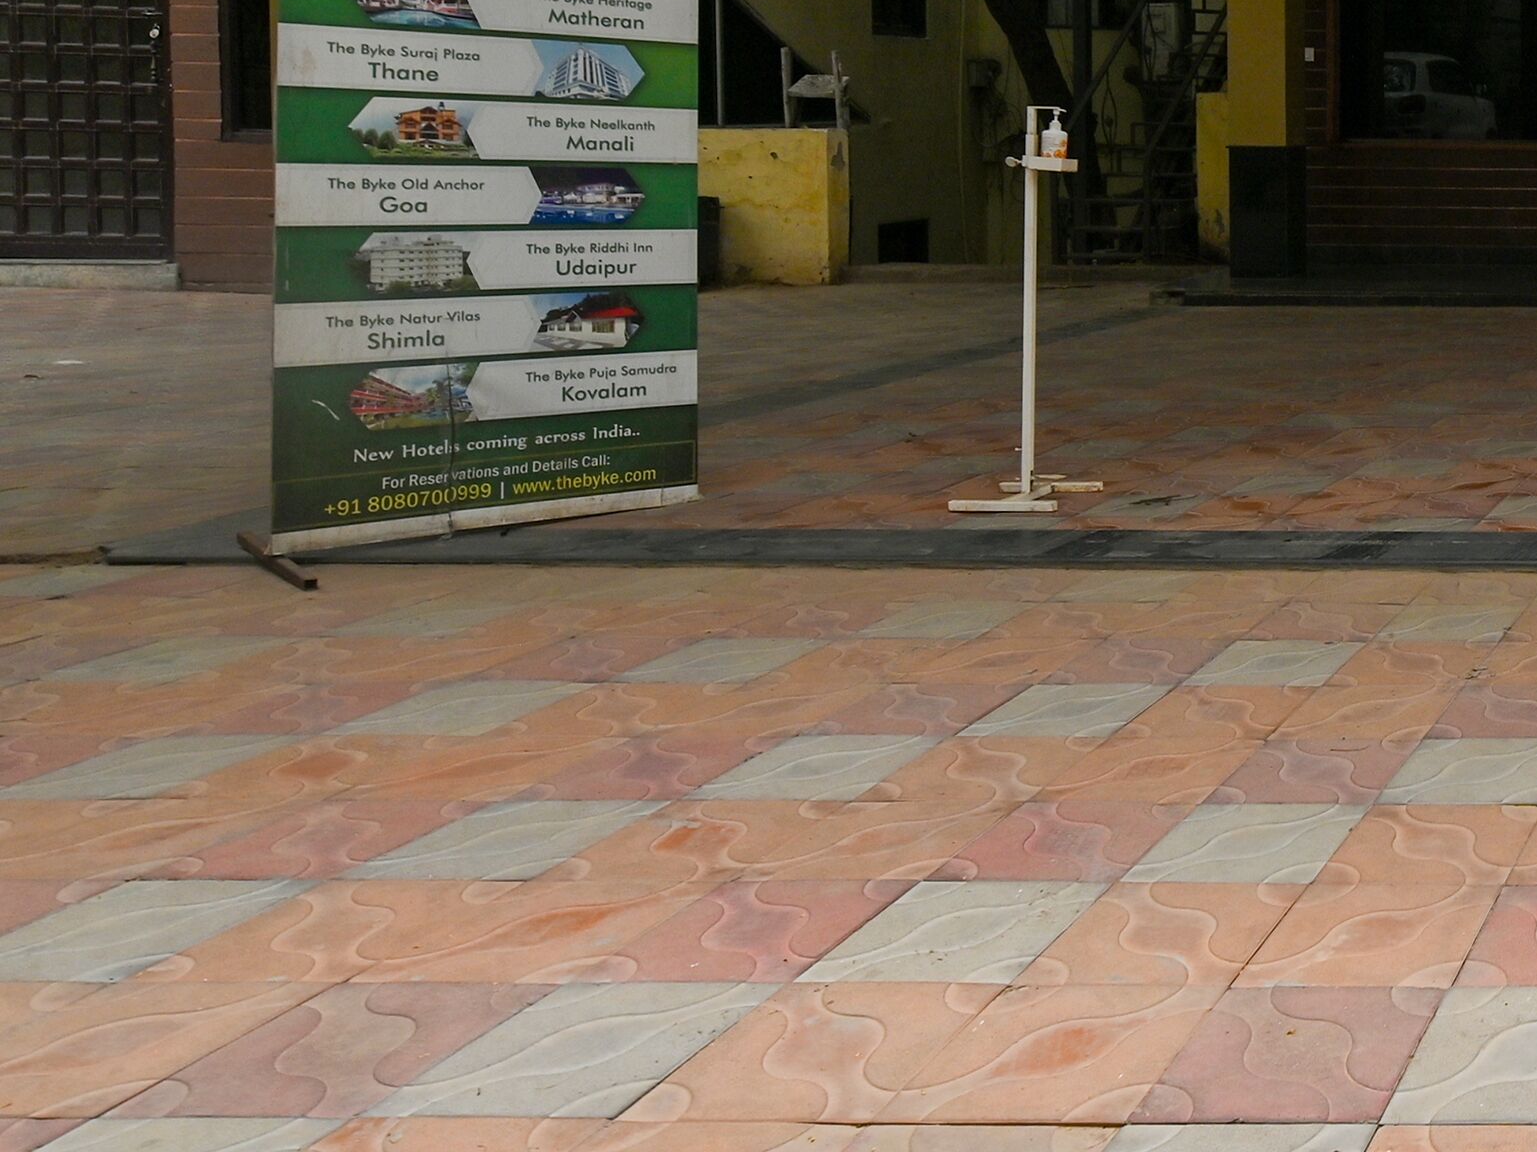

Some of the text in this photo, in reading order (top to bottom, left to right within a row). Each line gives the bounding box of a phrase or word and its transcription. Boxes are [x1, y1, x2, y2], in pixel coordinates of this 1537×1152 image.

[549, 10, 644, 30] Matheran
[327, 42, 480, 62] The Byke Suraj Plaza
[368, 61, 439, 82] Thane
[527, 117, 655, 133] The Byke Neelkanth
[566, 135, 634, 152] Manali
[328, 178, 485, 194] The Byke Old Anchor
[379, 196, 428, 214] Goa
[526, 241, 653, 258] The Byke Riddhi Inn
[556, 260, 636, 279] Udaipur
[326, 316, 354, 328] The
[360, 315, 395, 330] Byke
[367, 332, 445, 349] Shimla
[526, 364, 677, 384] The Byke Puja Samudra
[561, 383, 647, 402] Kovalam
[353, 447, 394, 463] New
[402, 443, 460, 459] Hotels
[467, 435, 527, 452] coming
[535, 428, 586, 446] across
[382, 475, 406, 489] For
[503, 462, 529, 476] and
[532, 456, 578, 473] Details
[582, 453, 610, 469] Call:
[324, 497, 360, 516] +91
[513, 468, 657, 495] www.thebyke.com
